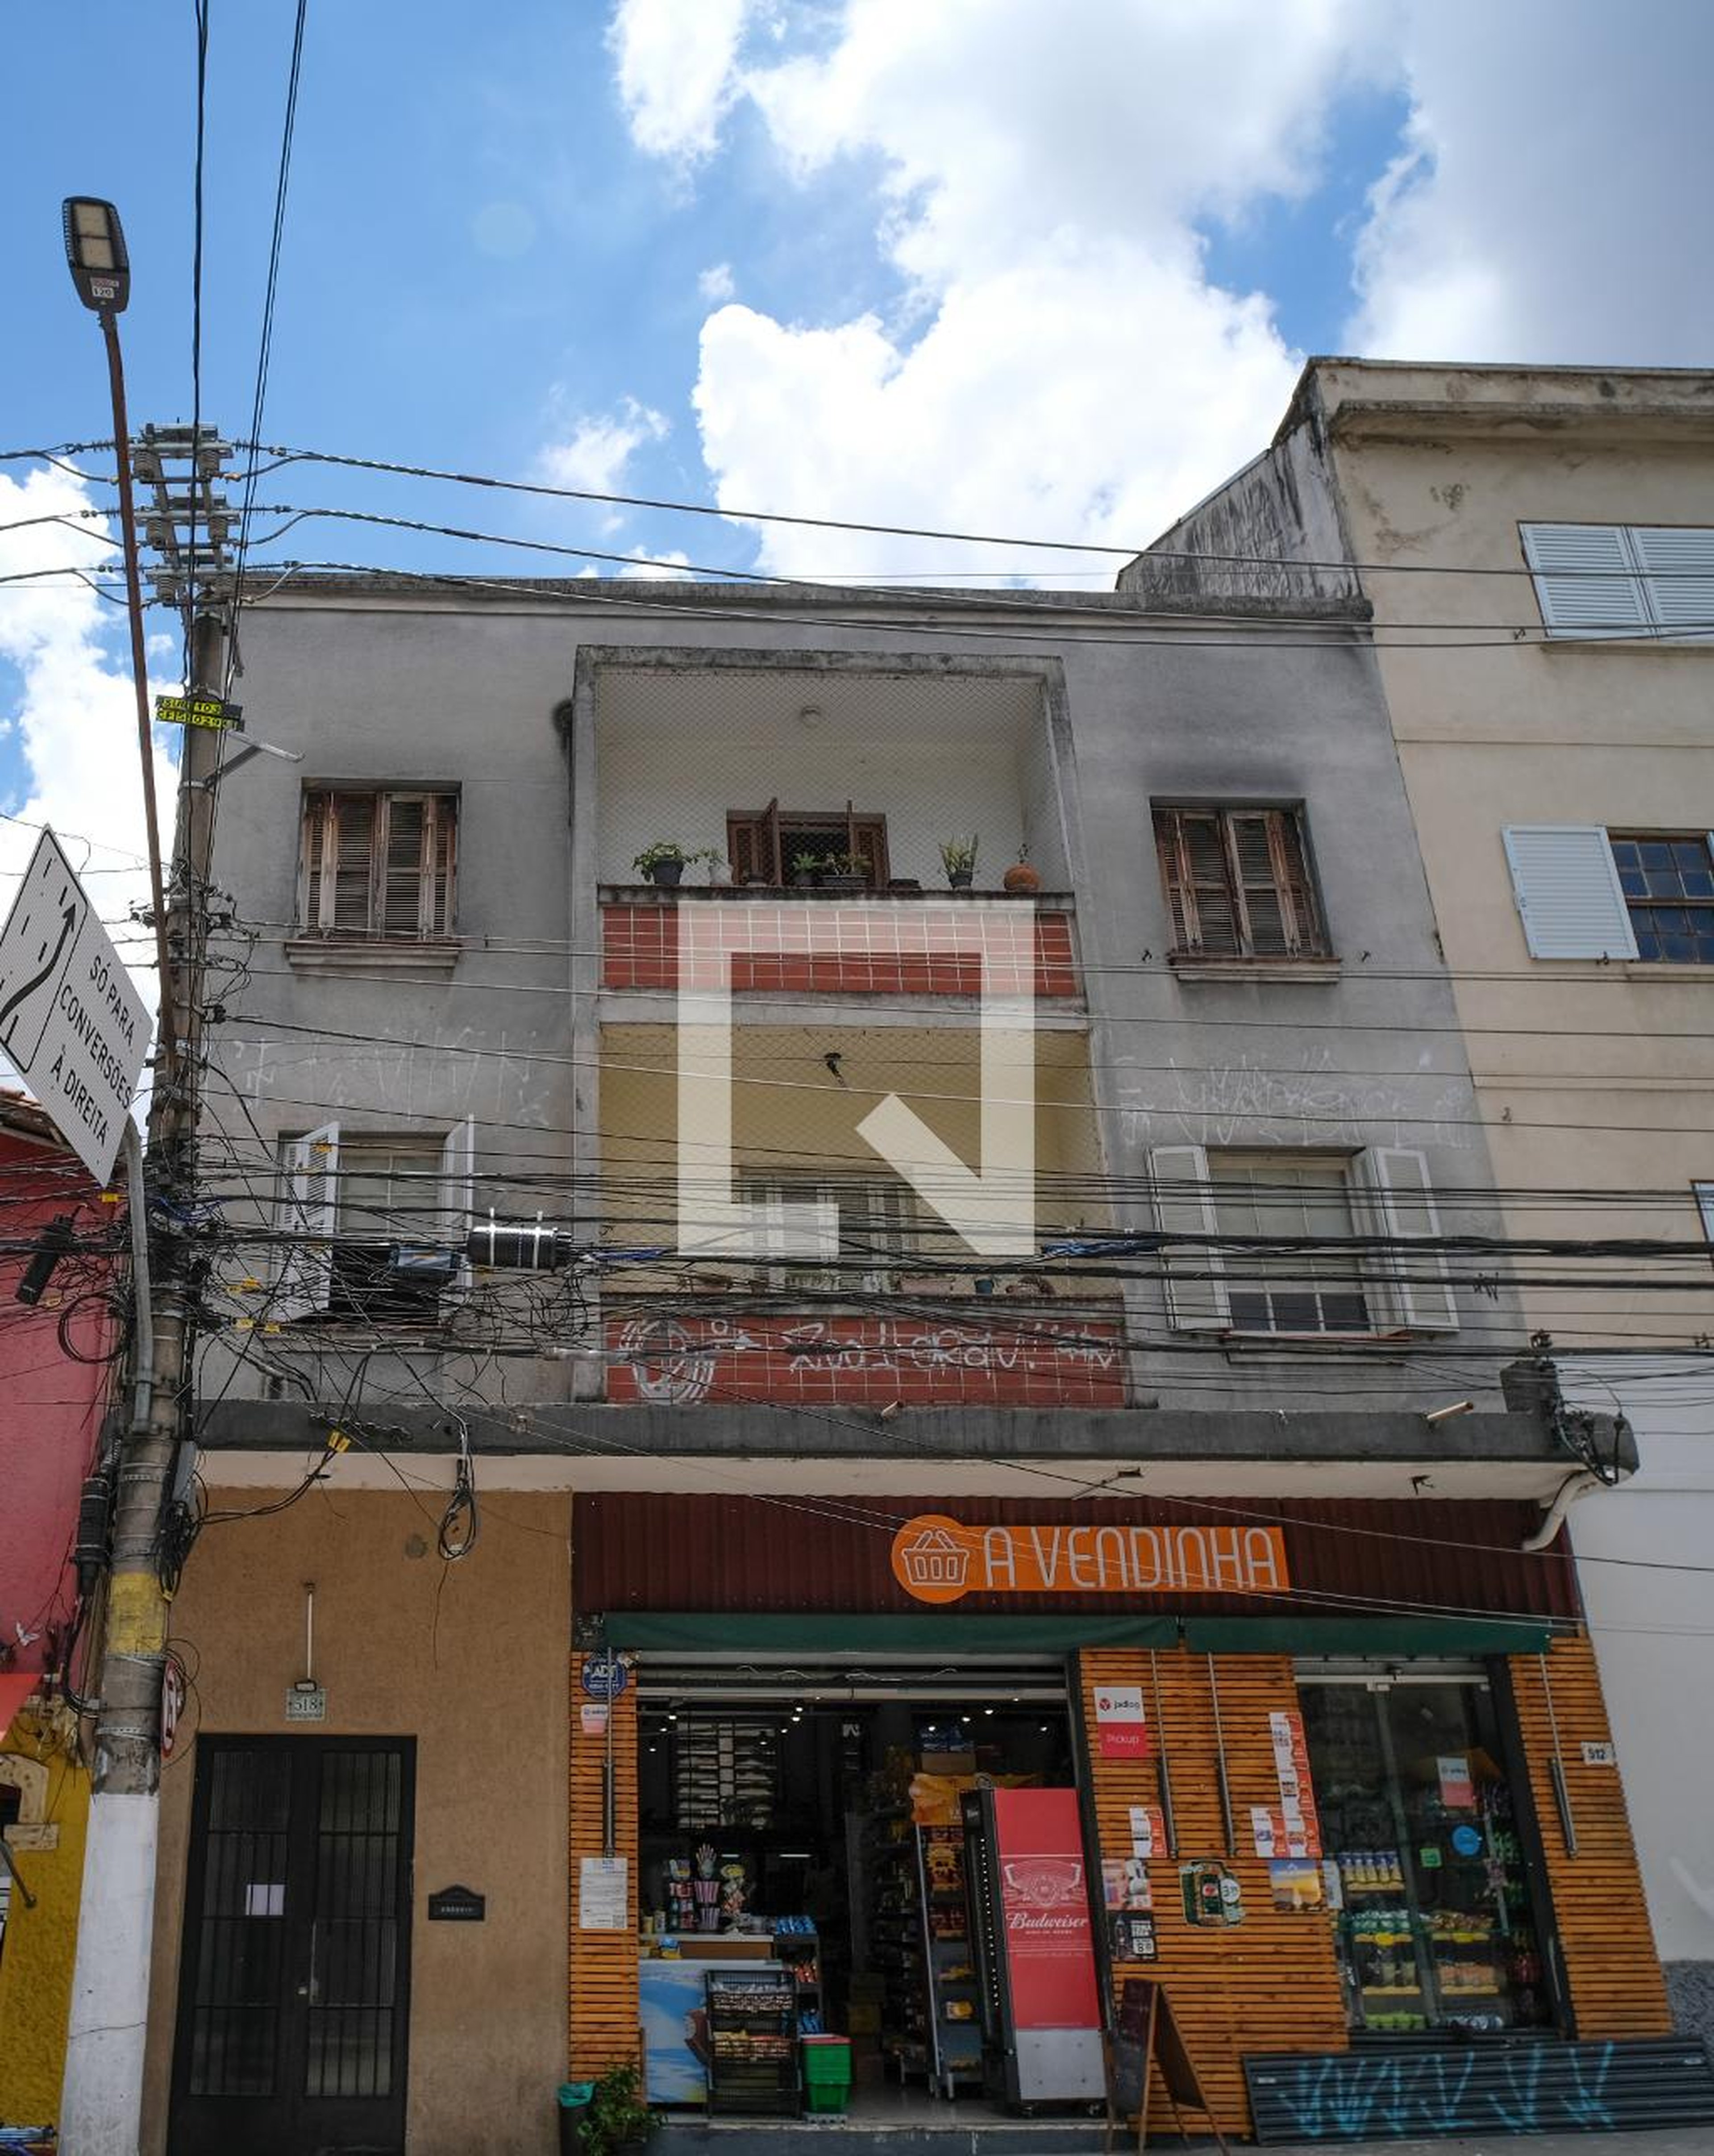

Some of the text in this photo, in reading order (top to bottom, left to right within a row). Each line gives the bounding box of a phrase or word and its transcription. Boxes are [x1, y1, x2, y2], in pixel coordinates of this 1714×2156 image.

[90, 955, 134, 1047] SÓ PARA
[60, 984, 132, 1110] CONVERSÕES
[63, 1069, 108, 1147] DIREITA
[983, 1526, 1278, 1589] A VENDINHA
[294, 1697, 318, 1711] 518
[1005, 1911, 1088, 1929] Budweiser
